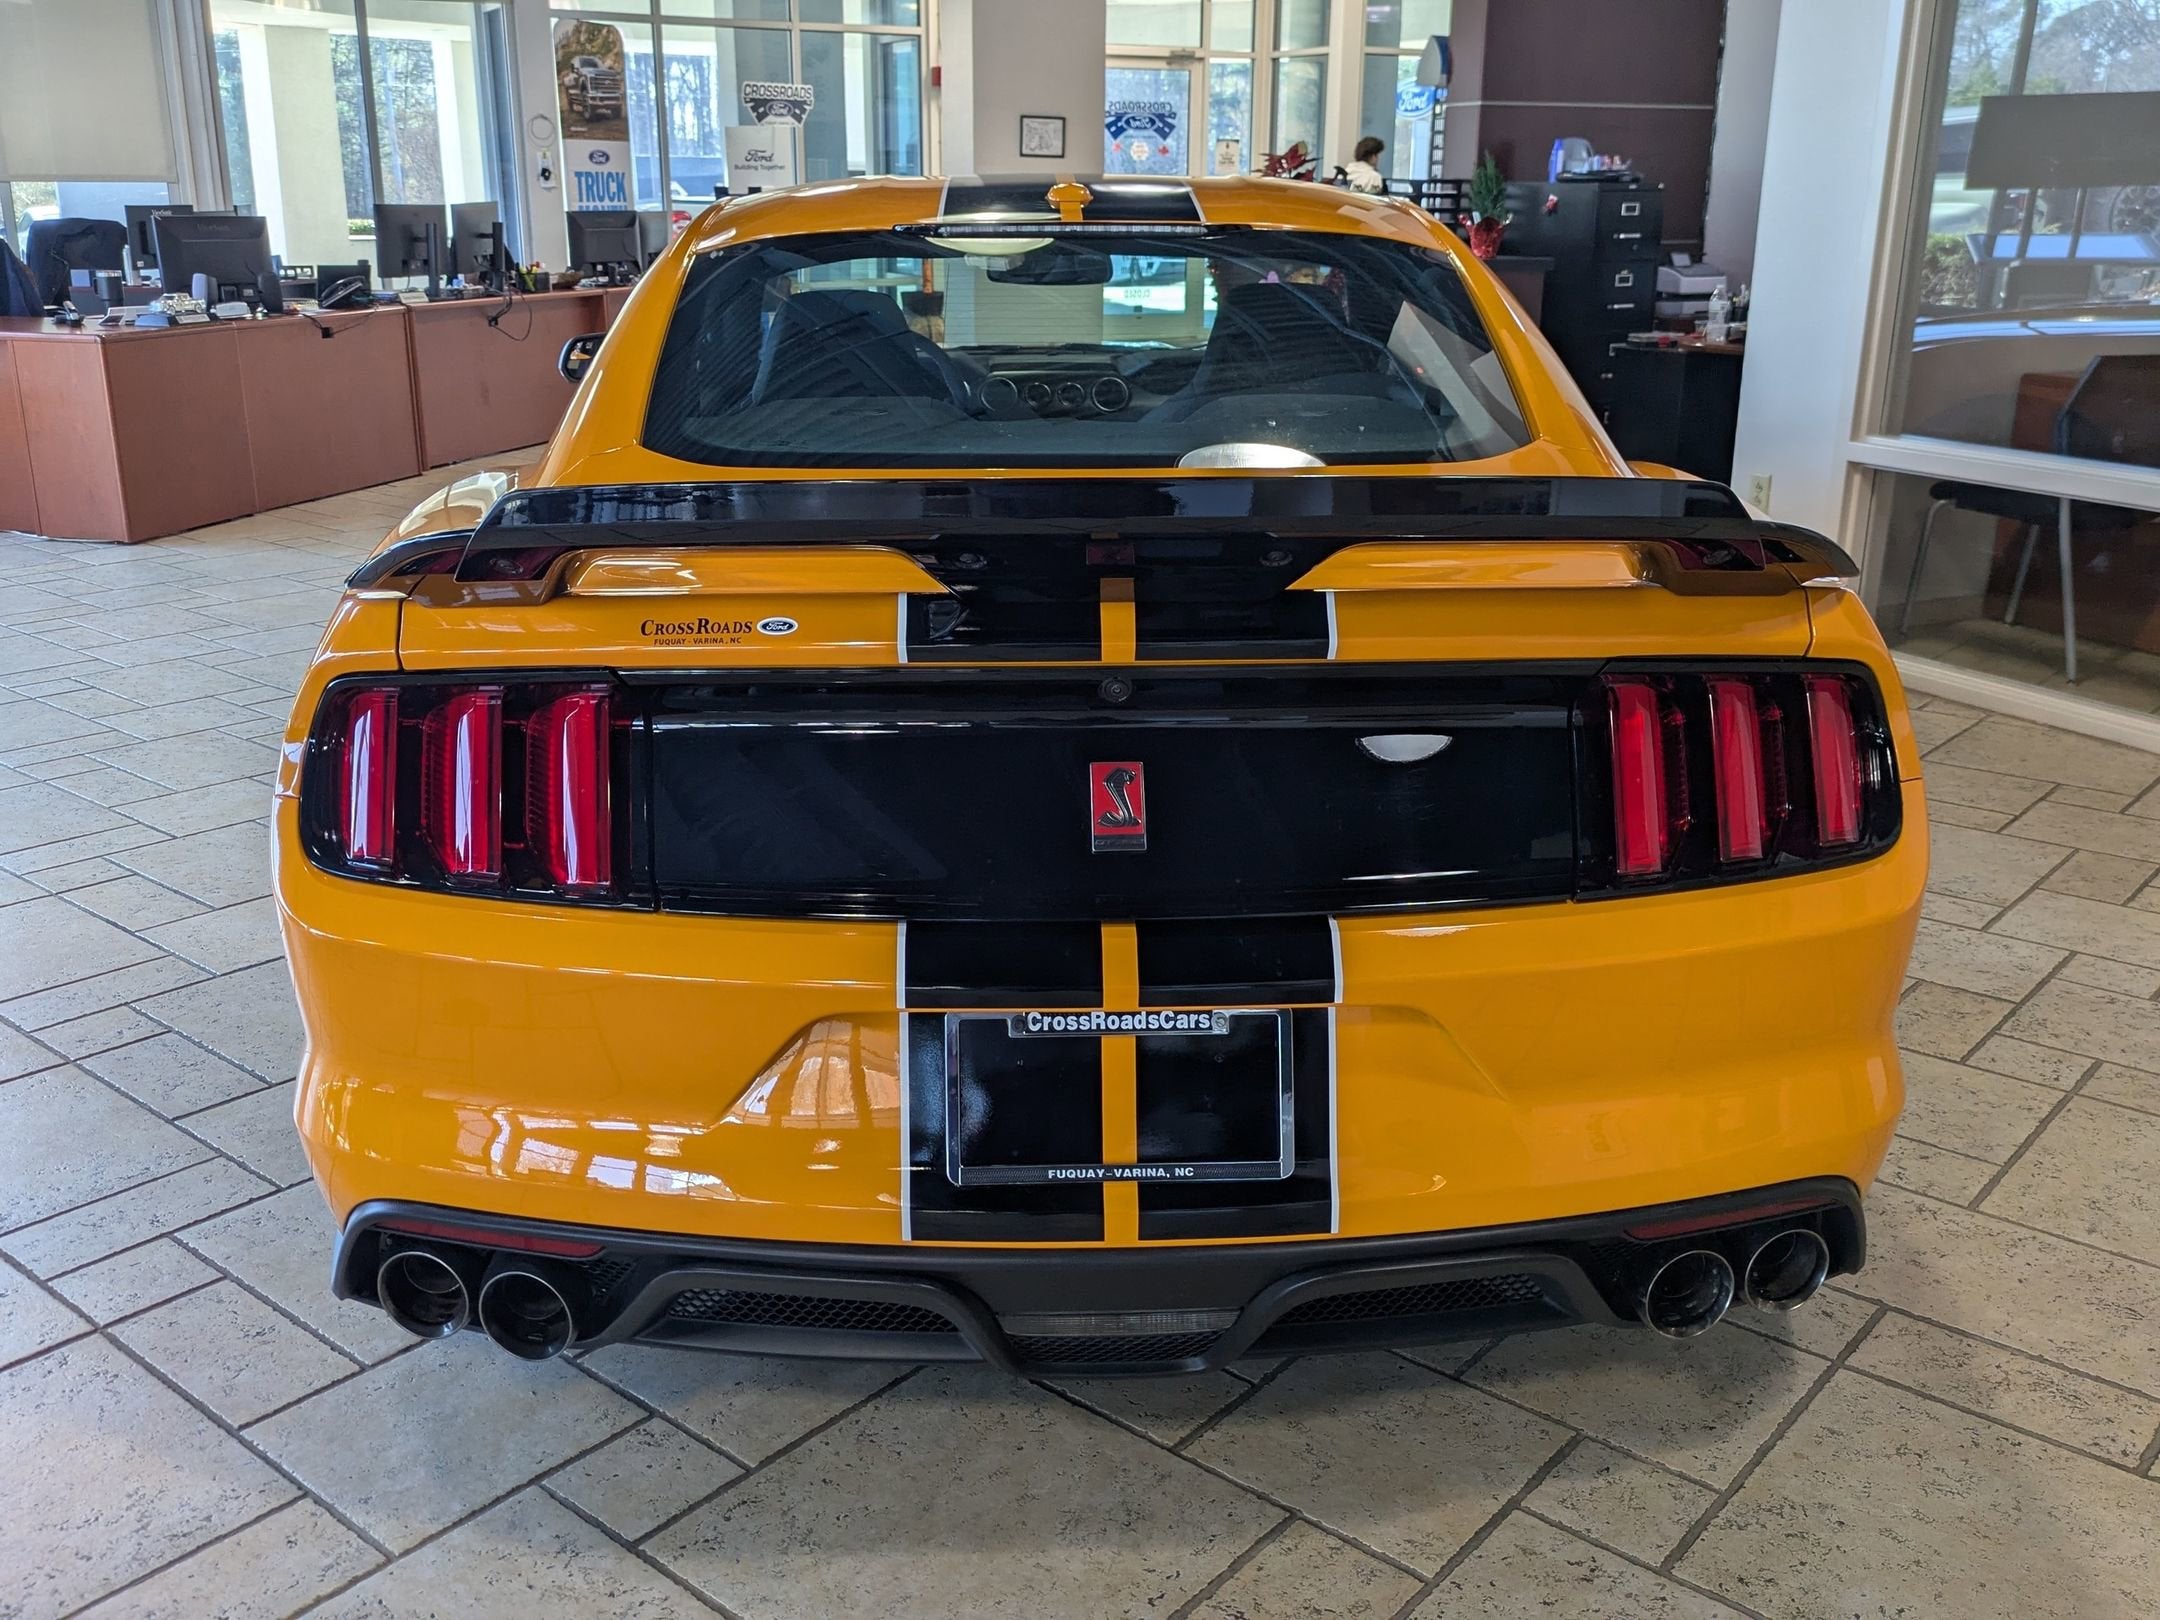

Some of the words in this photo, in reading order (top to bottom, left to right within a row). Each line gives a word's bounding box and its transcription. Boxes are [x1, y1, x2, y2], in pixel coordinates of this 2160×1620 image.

[743, 83, 812, 99] CROSSROADS
[1398, 87, 1429, 111] Ford
[744, 148, 775, 162] Ford
[734, 163, 758, 171] Building
[760, 164, 785, 172] Together
[574, 170, 627, 203] TRUCK
[1027, 1010, 1211, 1031] CrossRoadsCars
[1174, 1167, 1195, 1177] NC
